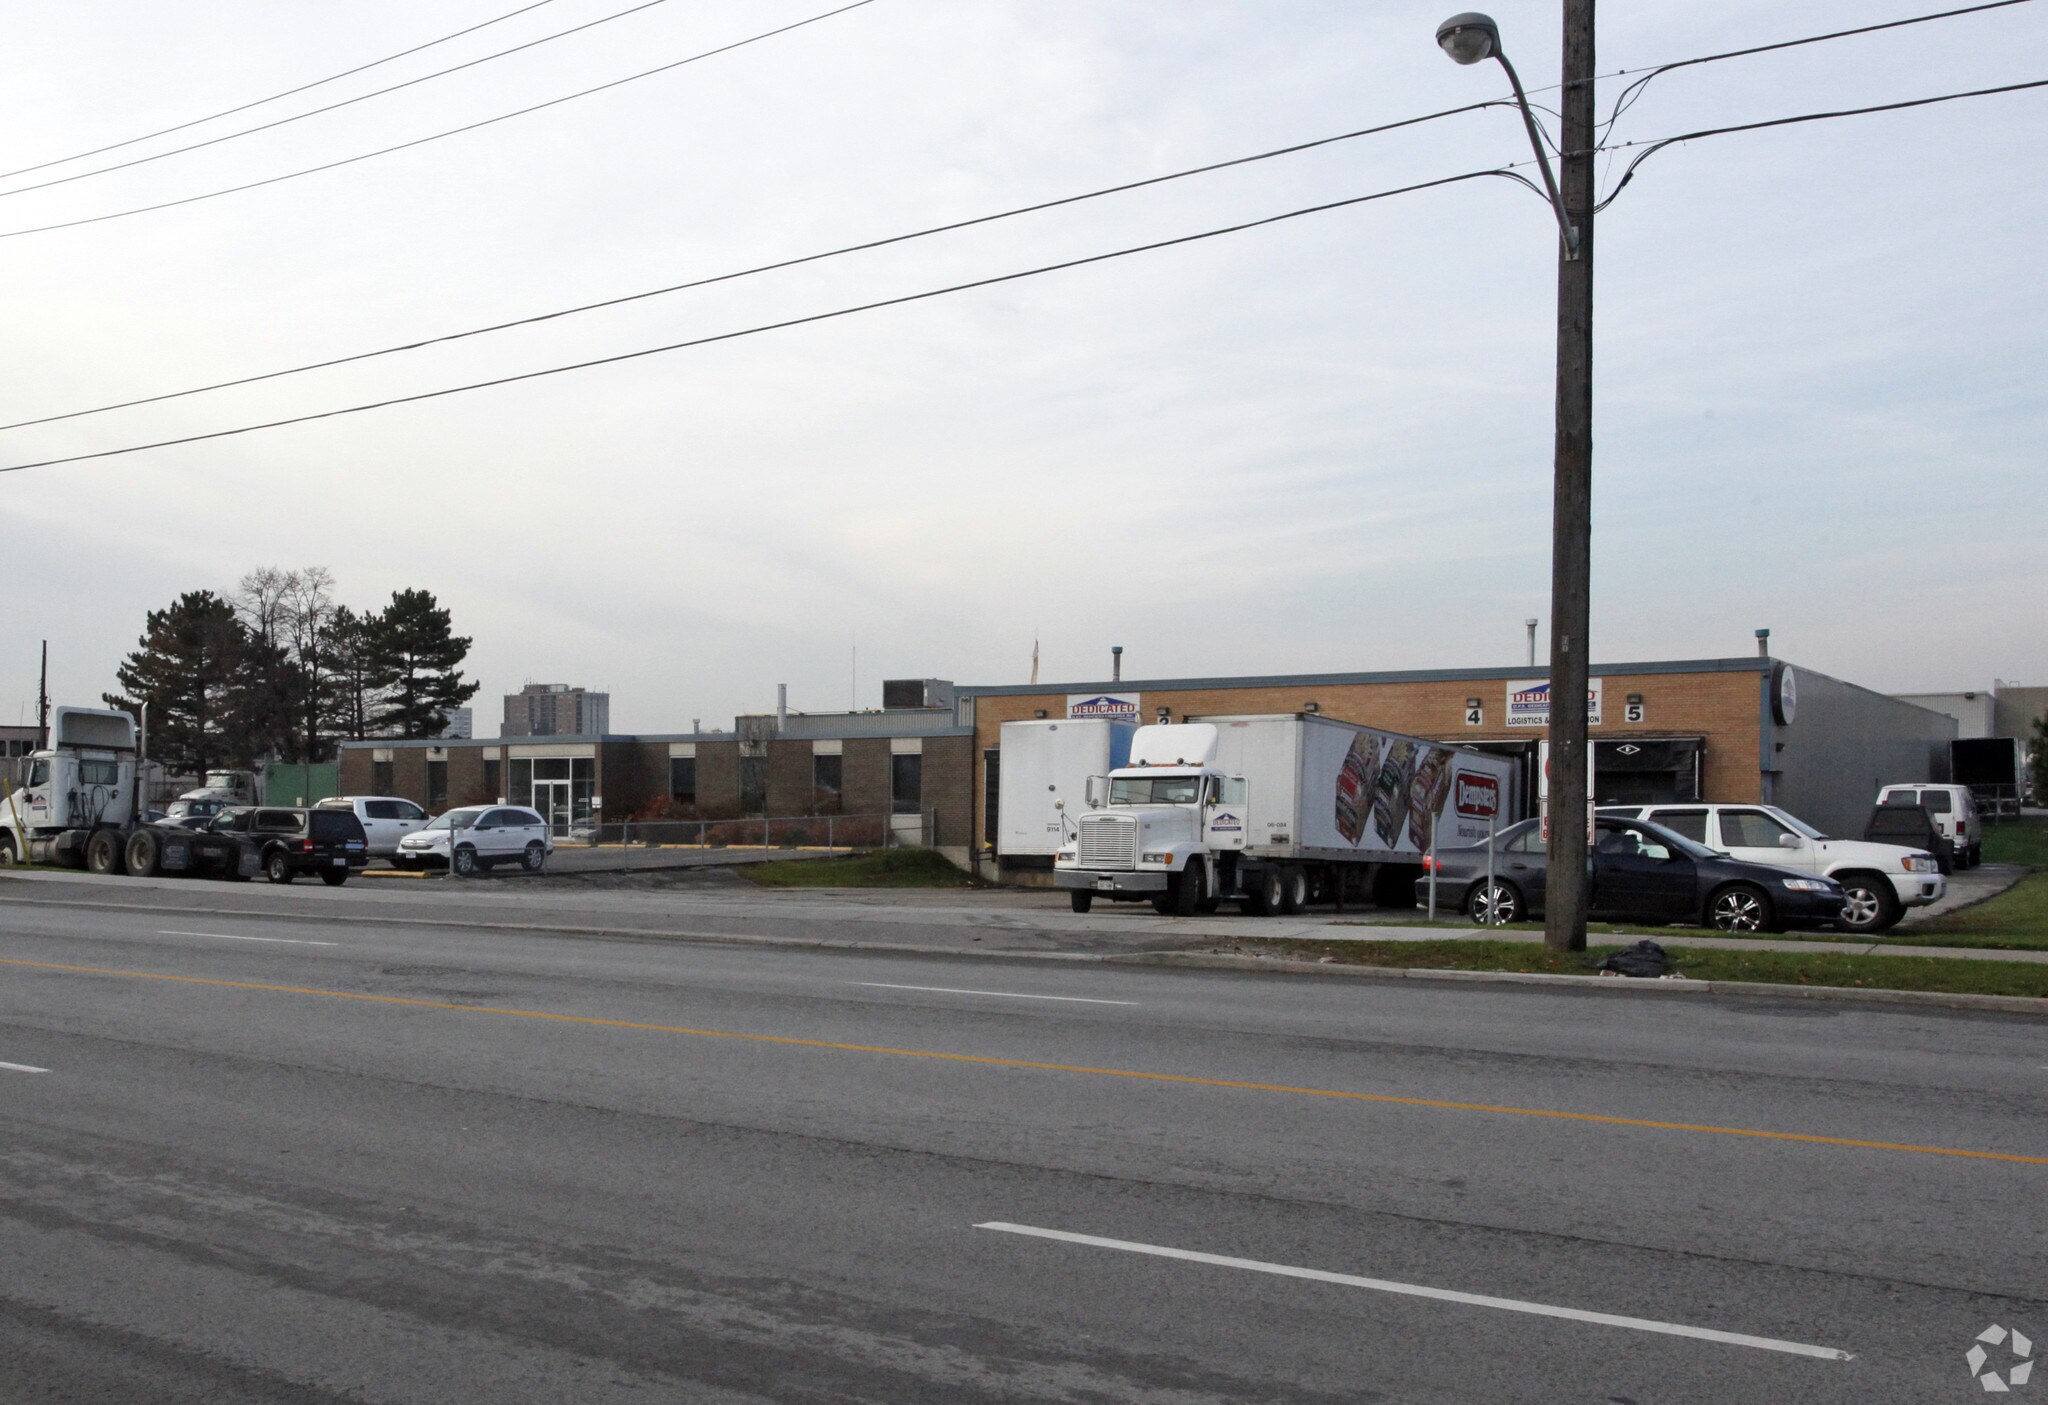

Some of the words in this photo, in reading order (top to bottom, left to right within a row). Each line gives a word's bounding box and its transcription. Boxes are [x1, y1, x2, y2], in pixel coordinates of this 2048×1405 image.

[1513, 691, 1595, 703] DEDID
[1072, 704, 1135, 714] DEDICATED
[1627, 706, 1641, 721] 5
[1467, 710, 1480, 724] 4
[1507, 717, 1543, 725] LOGISTICS
[1458, 780, 1497, 812] Dempster's
